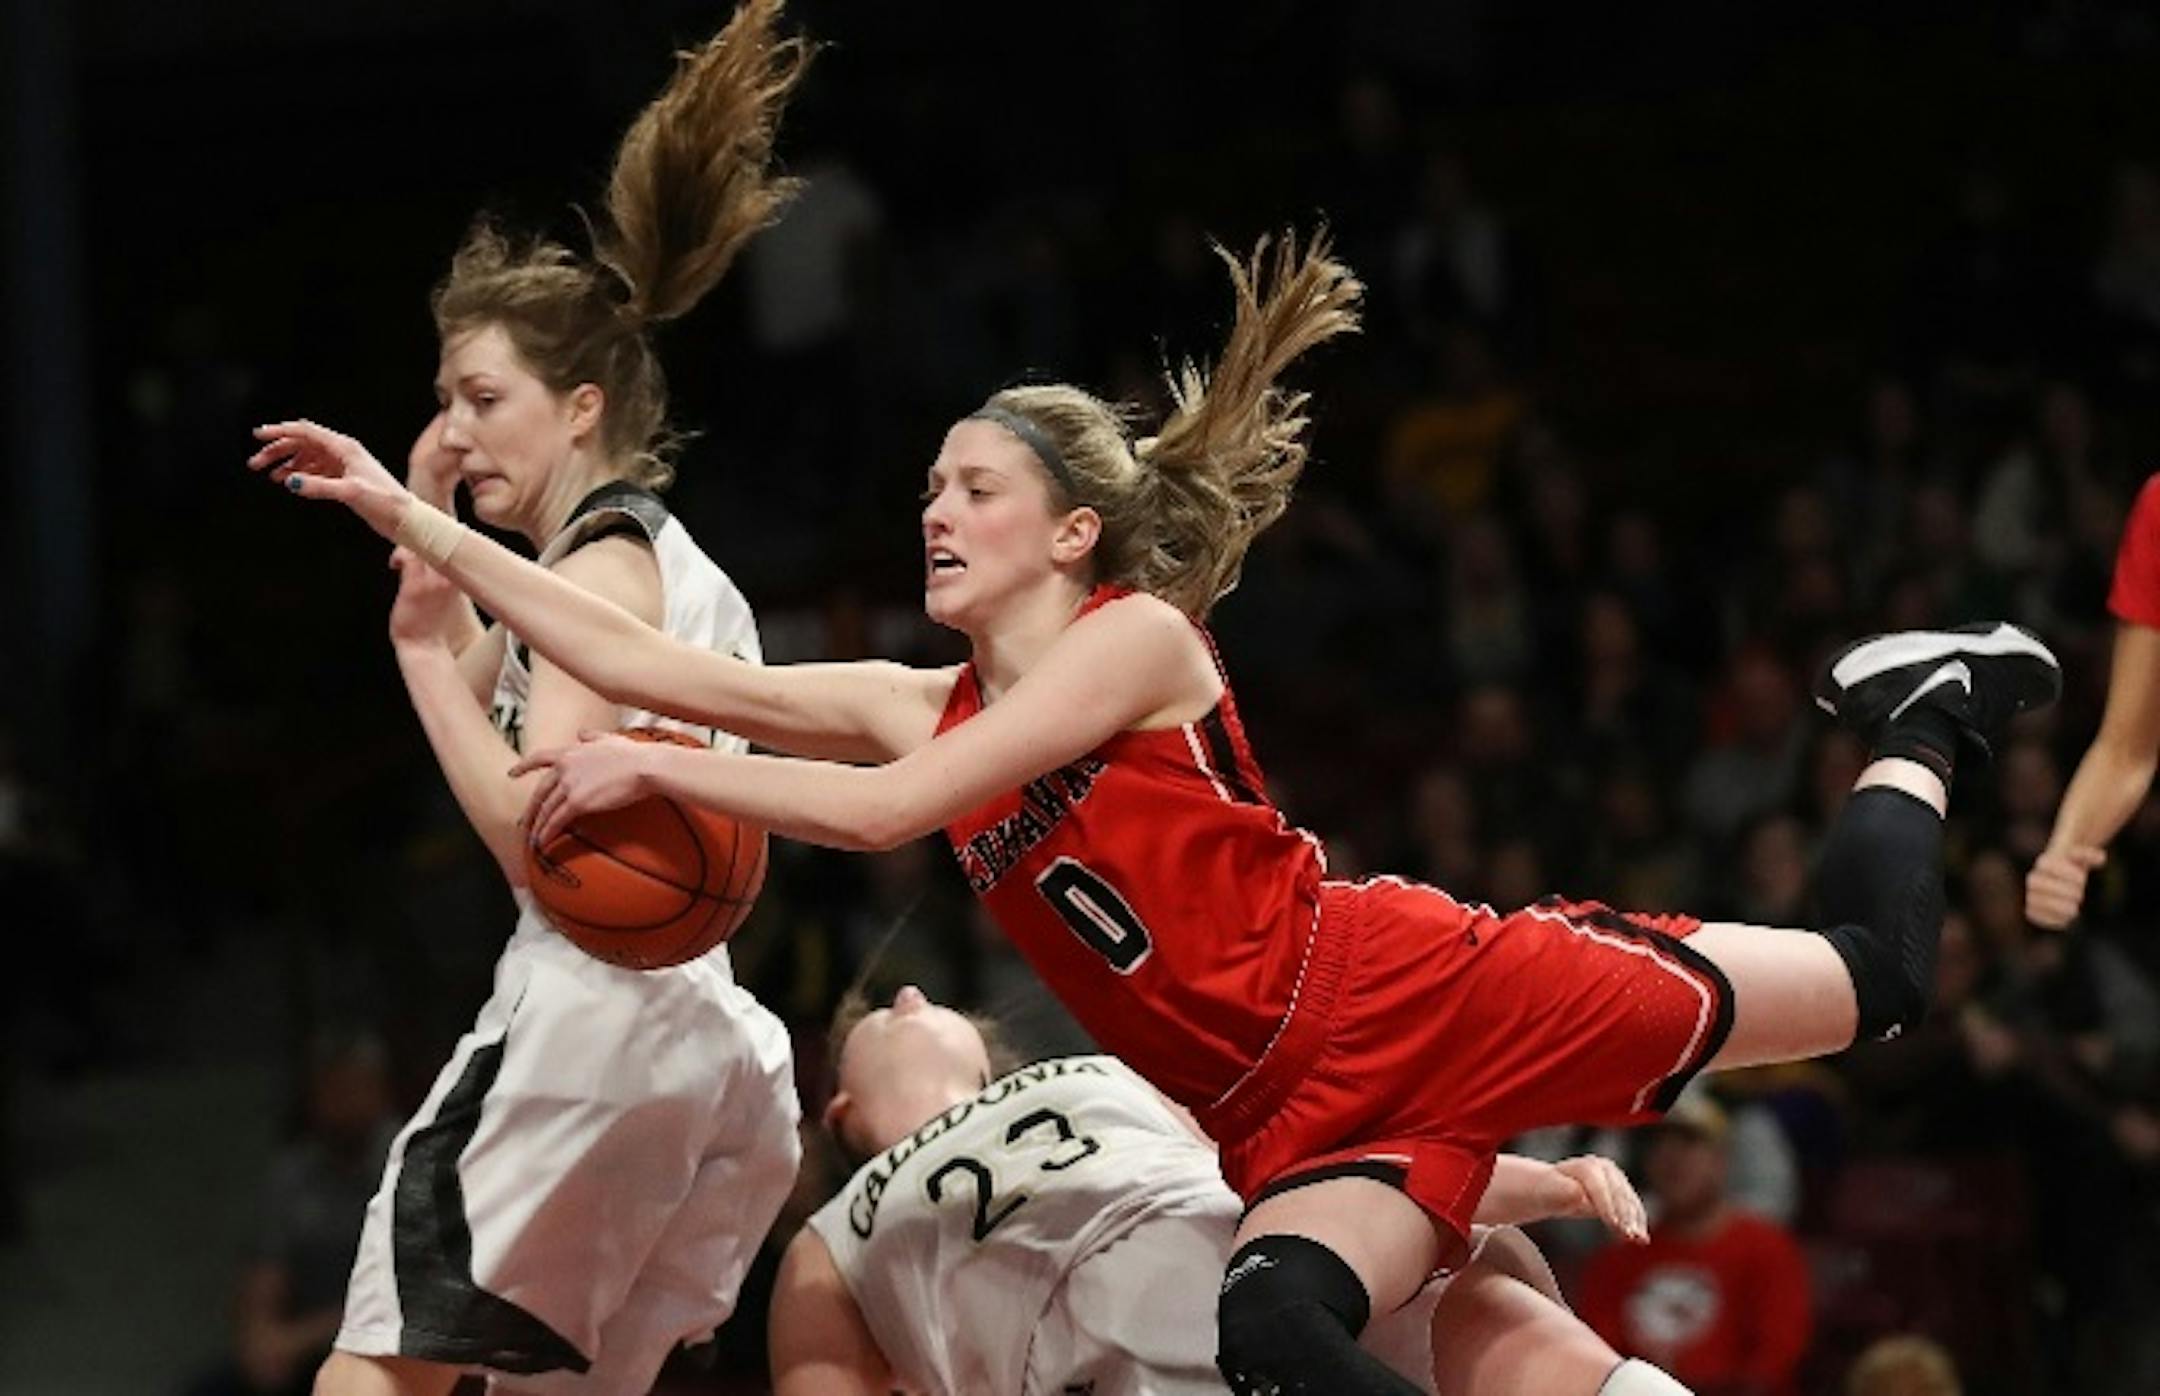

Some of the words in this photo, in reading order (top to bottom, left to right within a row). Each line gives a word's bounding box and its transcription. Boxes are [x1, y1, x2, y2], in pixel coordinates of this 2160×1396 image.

[1034, 855, 1153, 976] 0
[848, 1062, 1110, 1241] CALEDONIA
[925, 1107, 1101, 1242] 23
